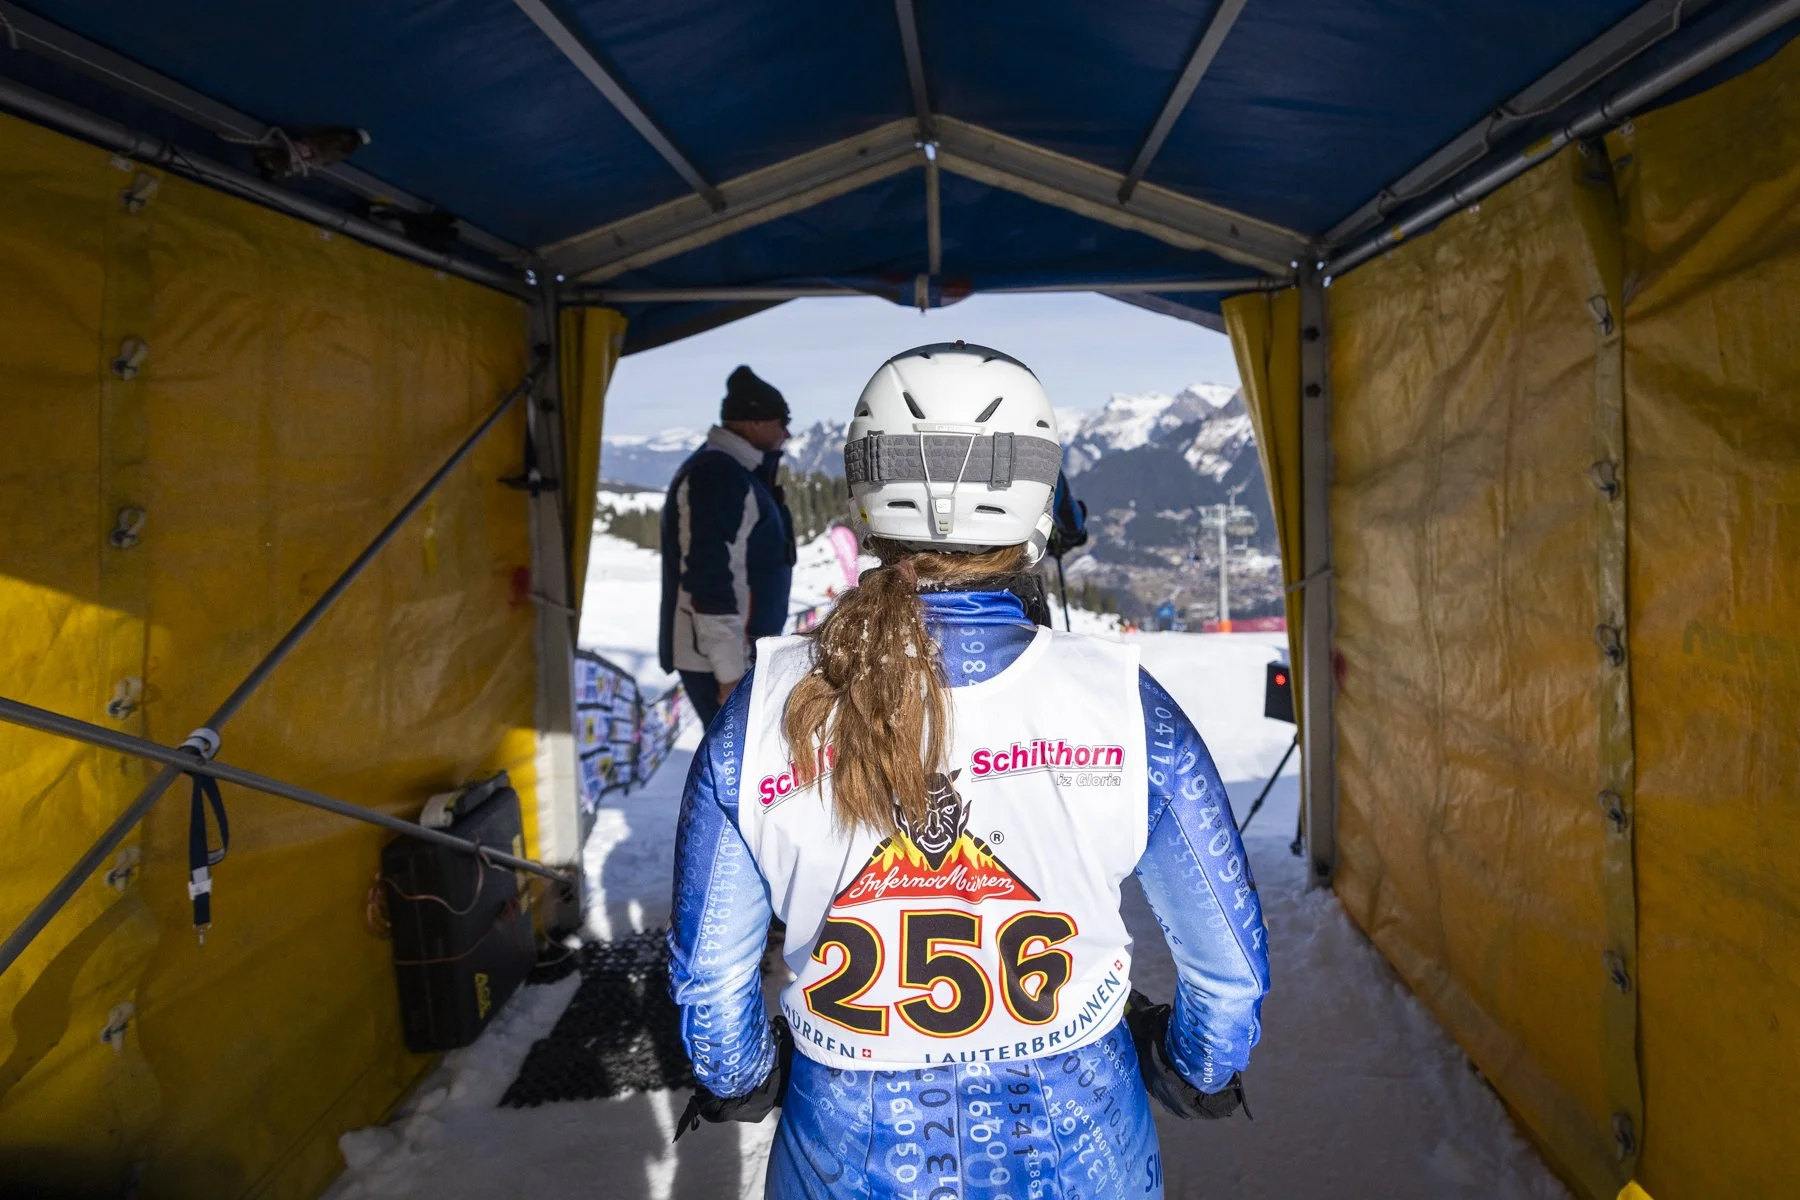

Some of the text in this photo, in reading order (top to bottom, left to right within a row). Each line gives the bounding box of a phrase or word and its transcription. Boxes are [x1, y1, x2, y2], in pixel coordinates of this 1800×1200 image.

[971, 740, 1124, 775] Schilthorn
[1076, 772, 1121, 787] Gloria
[1149, 706, 1174, 787] 04119
[803, 909, 1078, 1038] 256
[925, 970, 1121, 1064] LAUTERBRUNNEN
[1006, 1064, 1036, 1156] 79541
